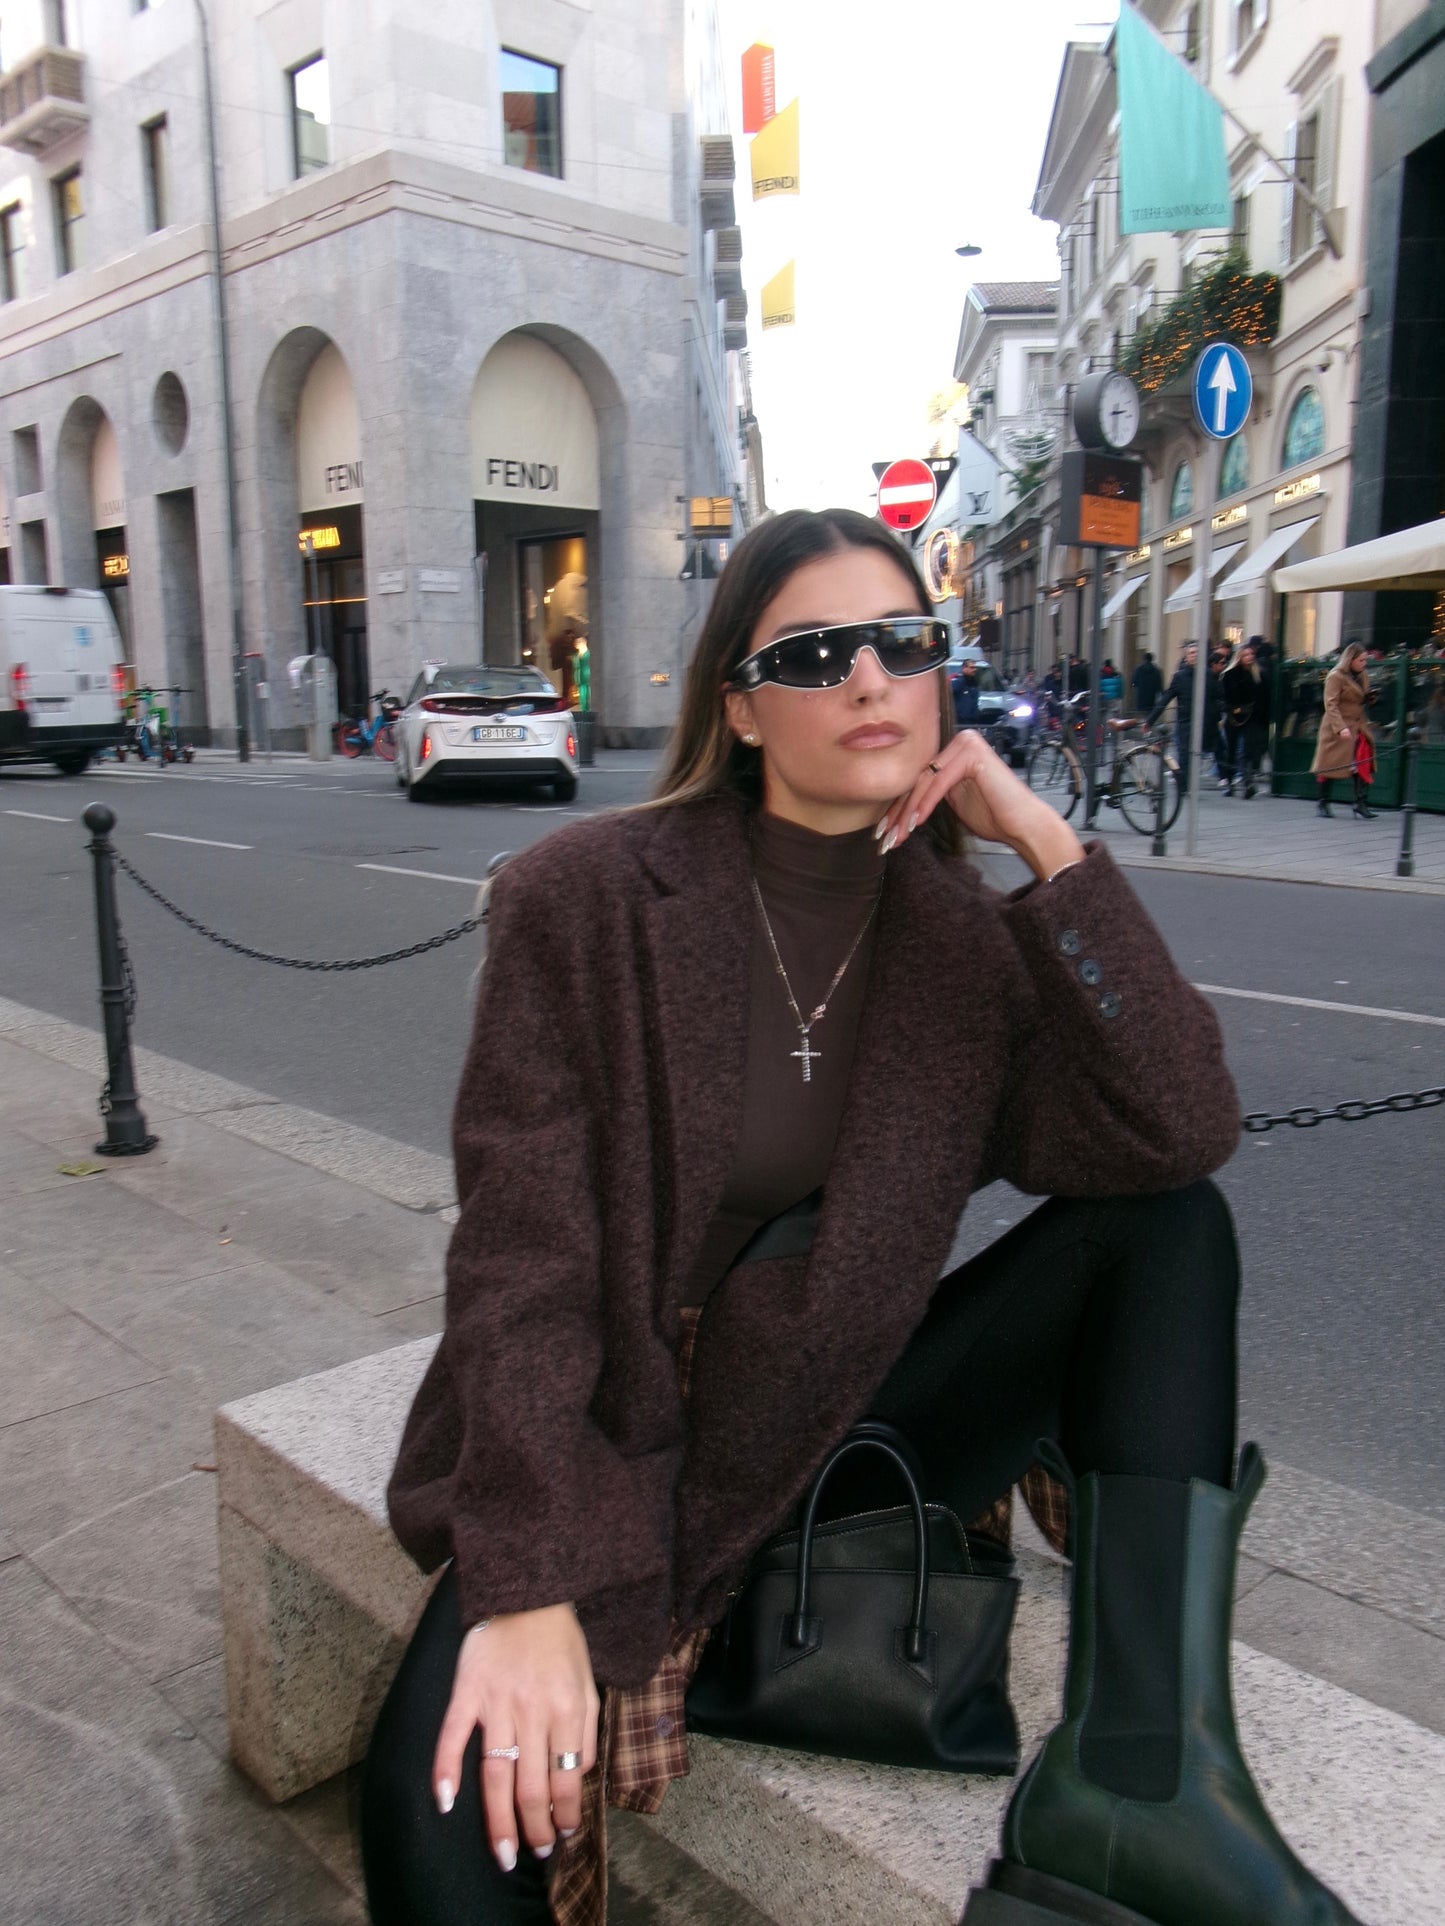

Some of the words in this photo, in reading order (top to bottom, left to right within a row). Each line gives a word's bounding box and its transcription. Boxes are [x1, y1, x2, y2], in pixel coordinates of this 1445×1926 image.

[754, 176, 798, 193] FENDI
[325, 461, 363, 493] FEN
[486, 458, 558, 491] FENDI
